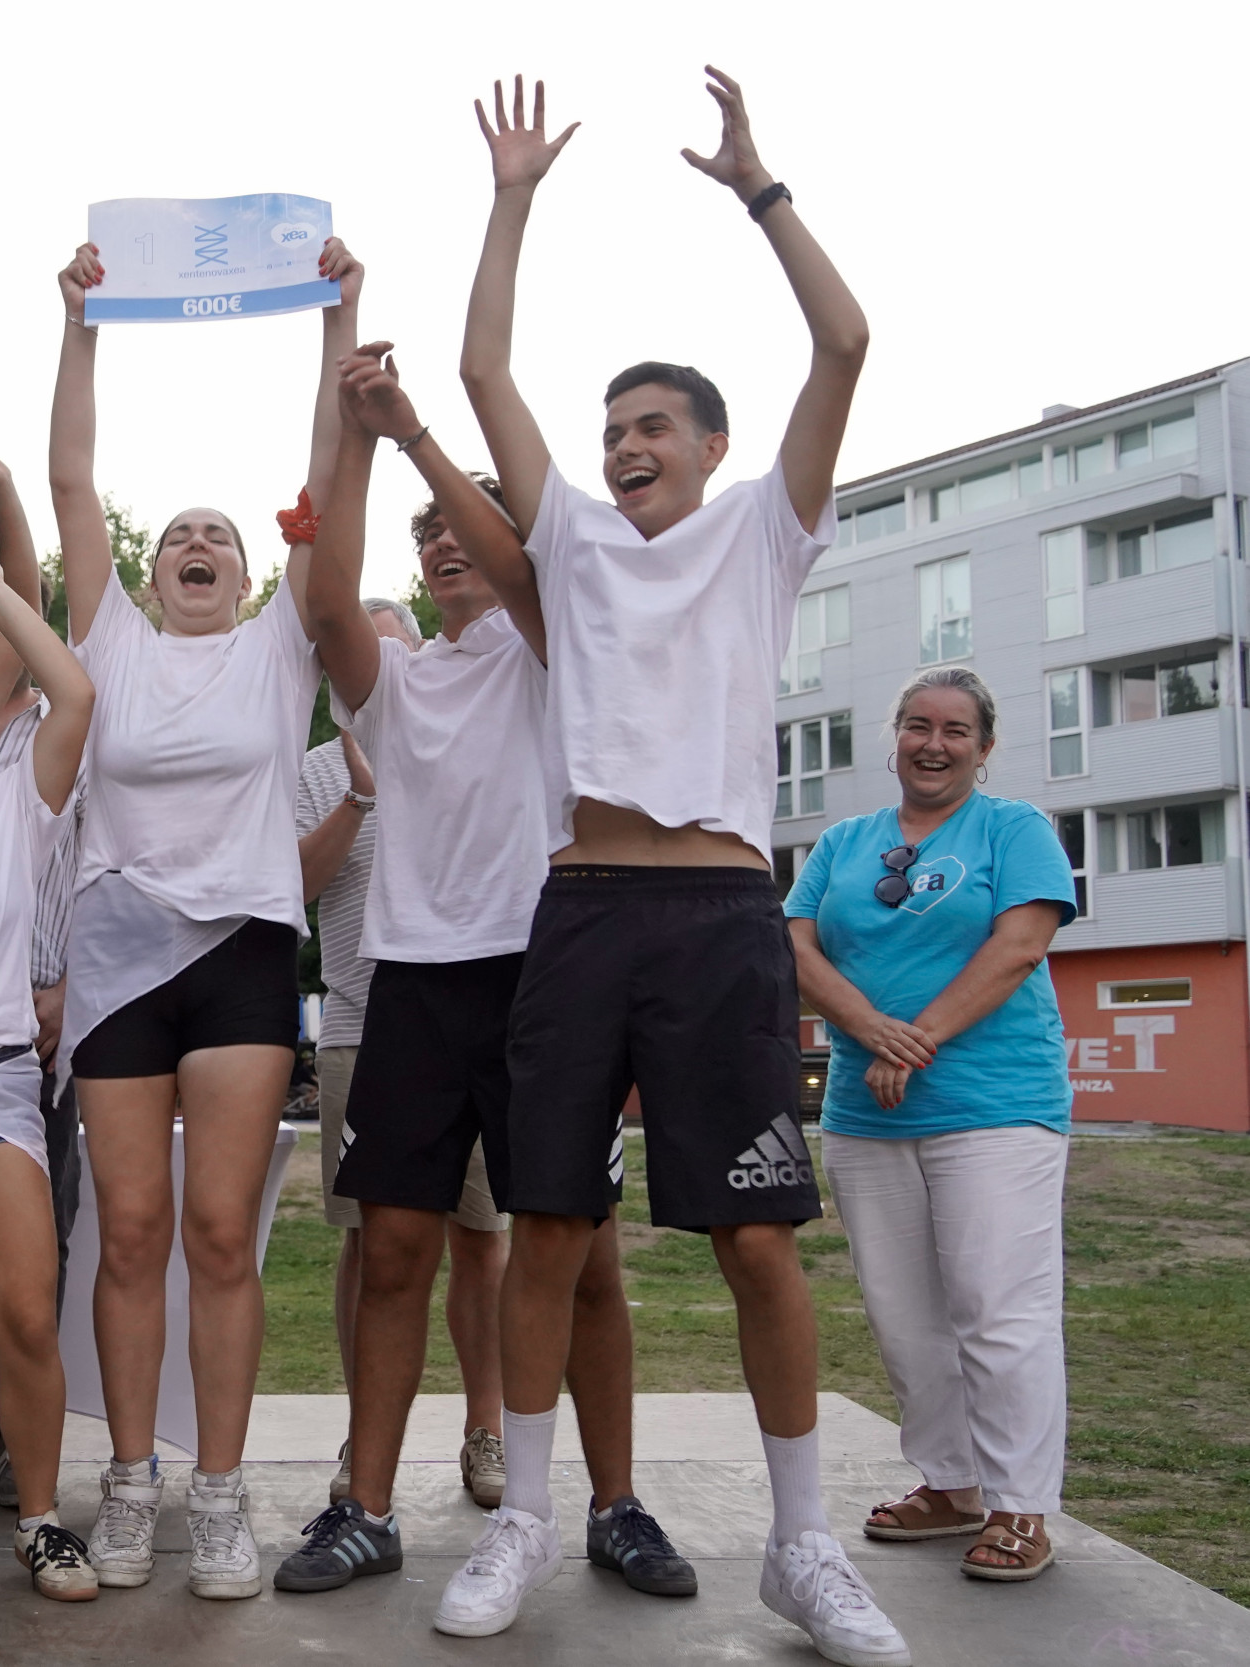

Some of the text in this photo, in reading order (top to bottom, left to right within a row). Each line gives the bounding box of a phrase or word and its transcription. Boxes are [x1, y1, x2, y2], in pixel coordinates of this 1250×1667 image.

[281, 231, 307, 243] xea
[135, 233, 154, 265] 1
[183, 295, 242, 316] 600€
